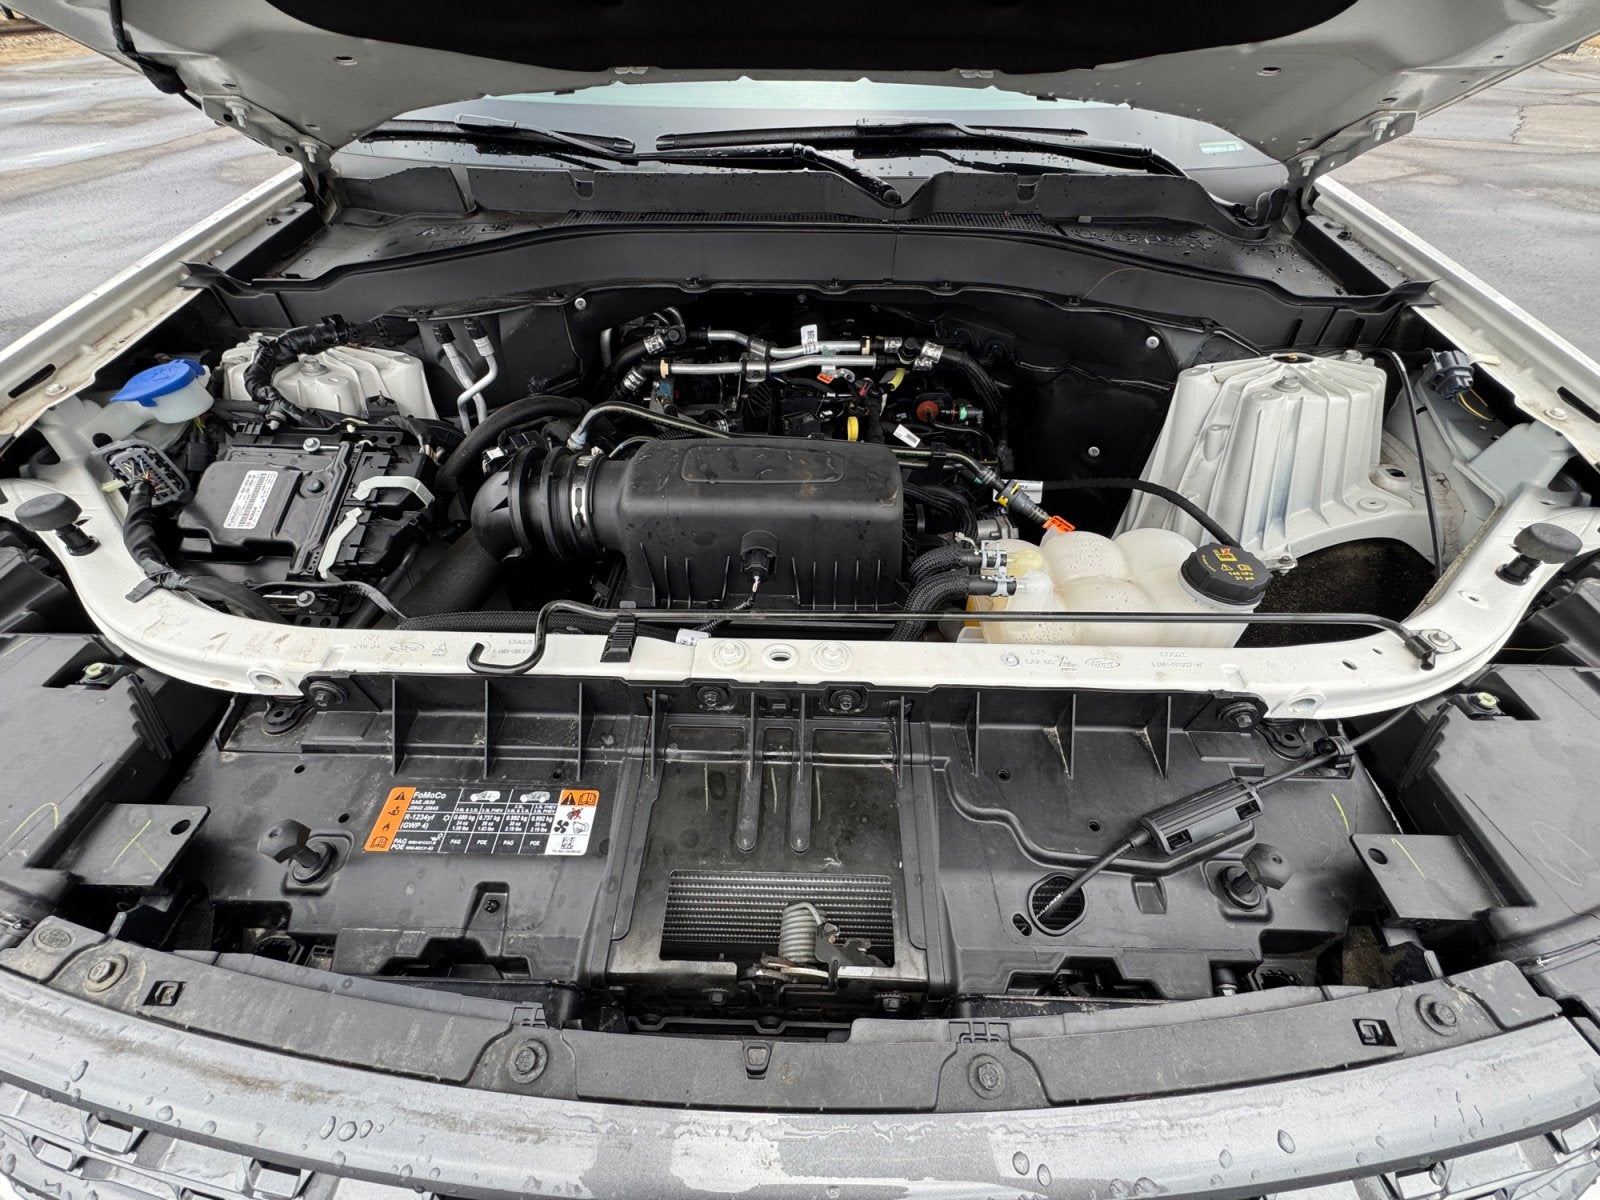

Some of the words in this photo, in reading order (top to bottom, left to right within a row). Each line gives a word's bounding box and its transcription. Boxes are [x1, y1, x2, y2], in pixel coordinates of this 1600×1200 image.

[413, 791, 447, 799] FoMoCo
[404, 813, 435, 822] R-1234yf
[400, 822, 422, 830] (GWP
[421, 822, 430, 830] 4)
